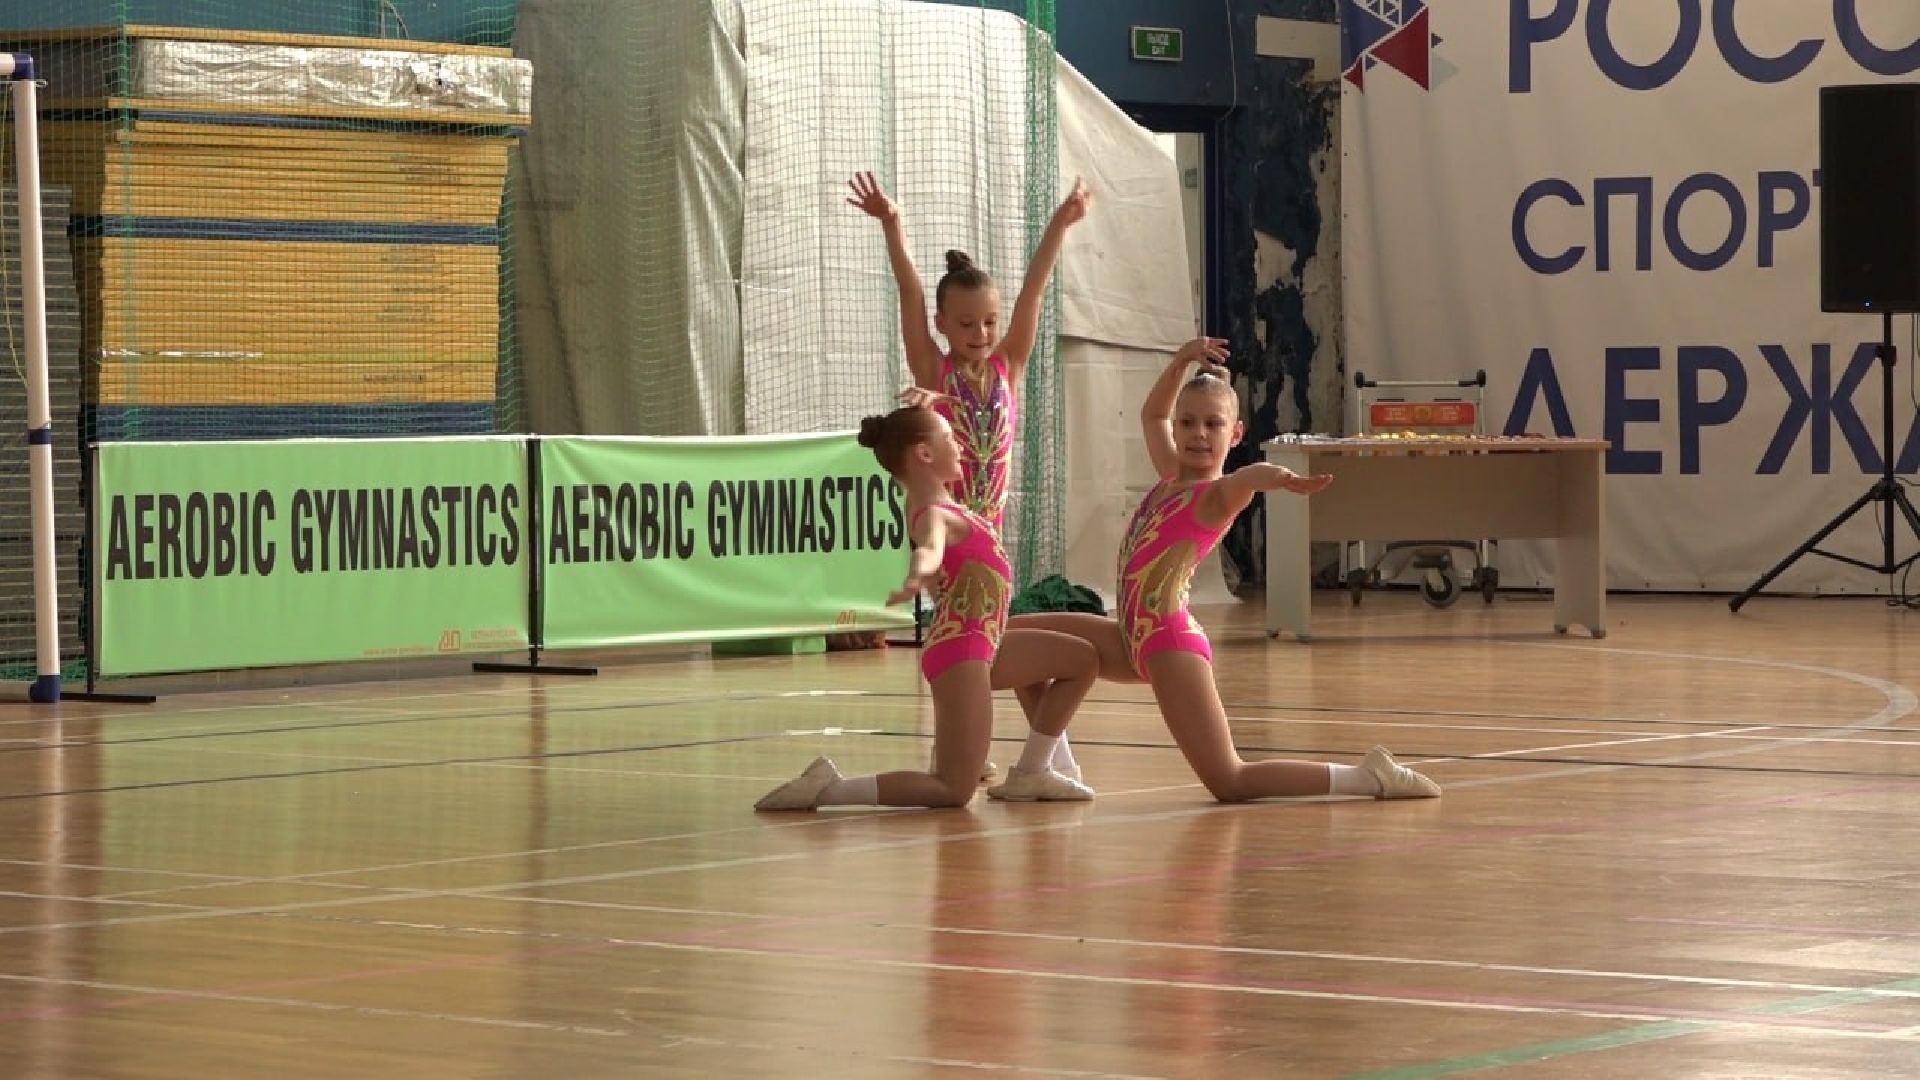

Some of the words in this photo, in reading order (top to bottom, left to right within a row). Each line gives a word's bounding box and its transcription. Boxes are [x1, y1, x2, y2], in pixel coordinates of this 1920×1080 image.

[1511, 169, 1823, 275] СПОР
[1503, 342, 1920, 475] ДЕРЖ
[106, 489, 276, 580] AEROBIC
[290, 483, 520, 574] GYMNASTICS
[549, 480, 695, 565] AEROBIC
[707, 474, 904, 559] GYMNASTICS
